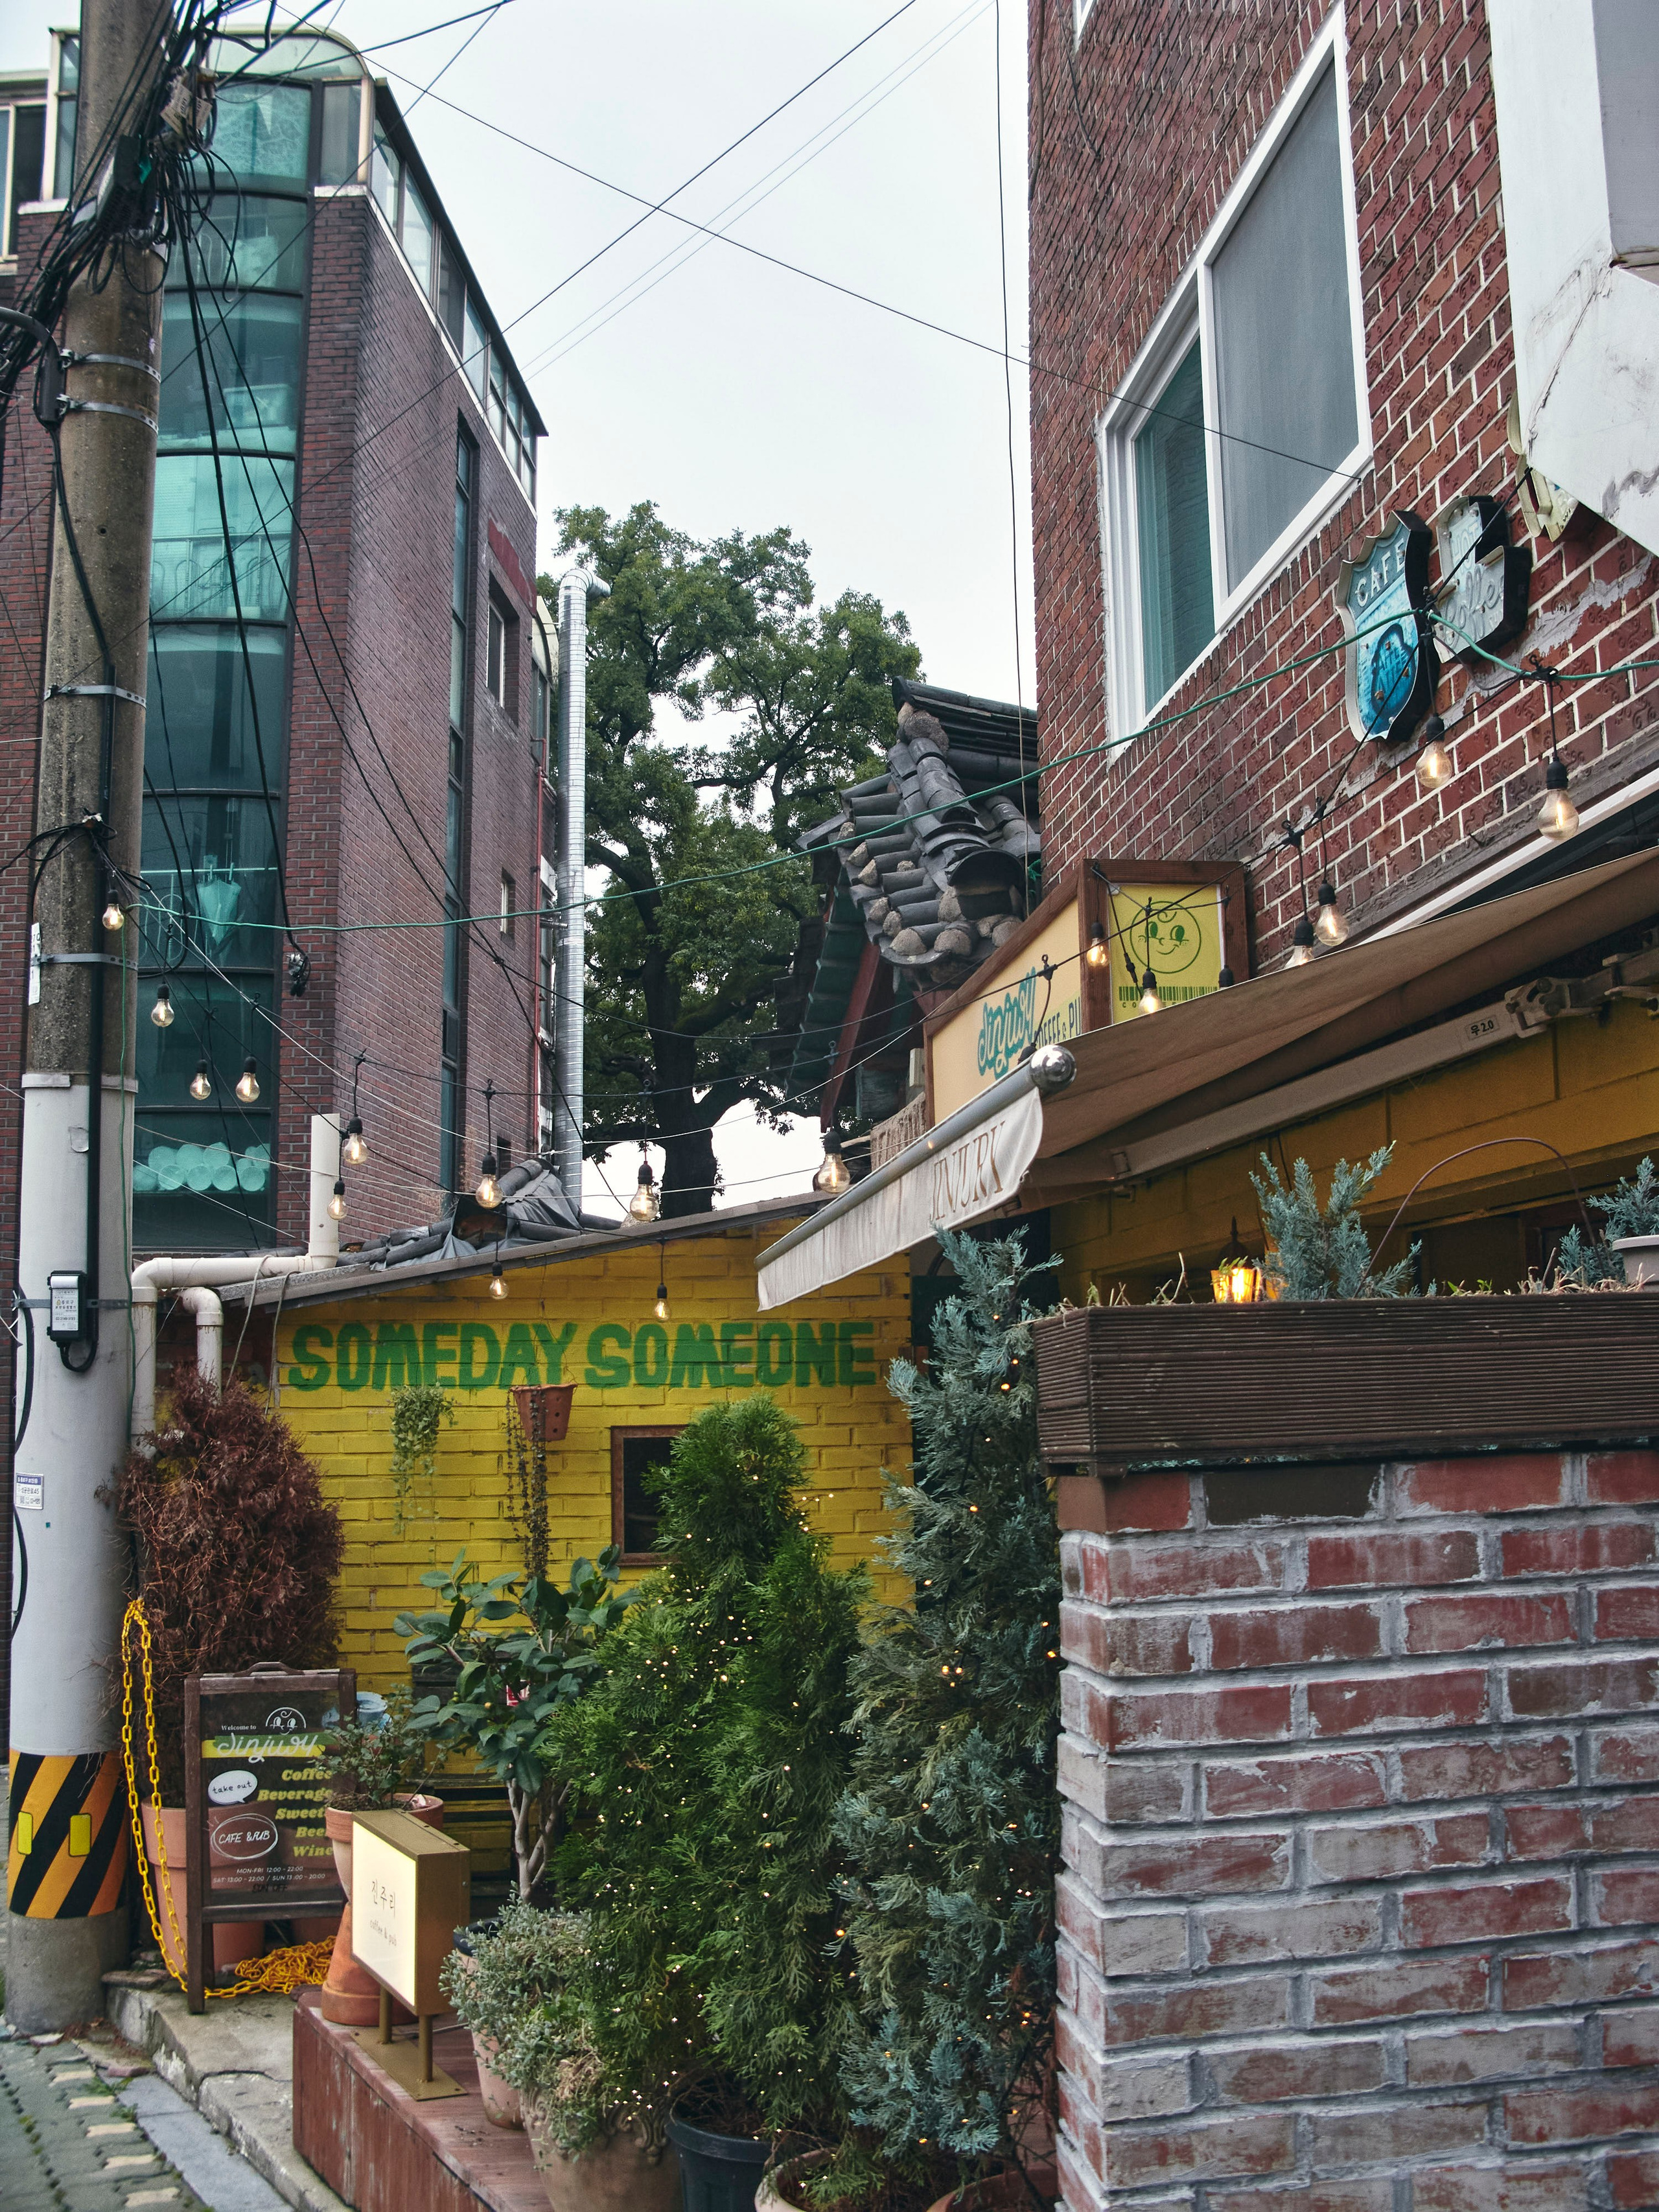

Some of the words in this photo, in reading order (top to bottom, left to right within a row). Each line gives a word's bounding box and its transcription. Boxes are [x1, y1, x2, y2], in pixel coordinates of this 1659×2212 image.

[1356, 538, 1405, 607] CAFE
[1444, 564, 1504, 651] Coffe
[1069, 996, 1081, 1038] PU
[1481, 1019, 1494, 1032] 2.0
[930, 1120, 1006, 1221] JINJURY
[288, 1323, 578, 1392] SOMEDAY
[585, 1322, 876, 1389] SOMEONE
[281, 1767, 333, 1782] Coffee
[213, 1785, 233, 1794] take
[237, 1780, 253, 1789] out
[275, 1807, 325, 1820] Sweet
[218, 1832, 244, 1845] CAFE
[296, 1826, 327, 1838] Bee
[292, 1845, 333, 1857] Wine
[371, 1878, 396, 1918] 진주리
